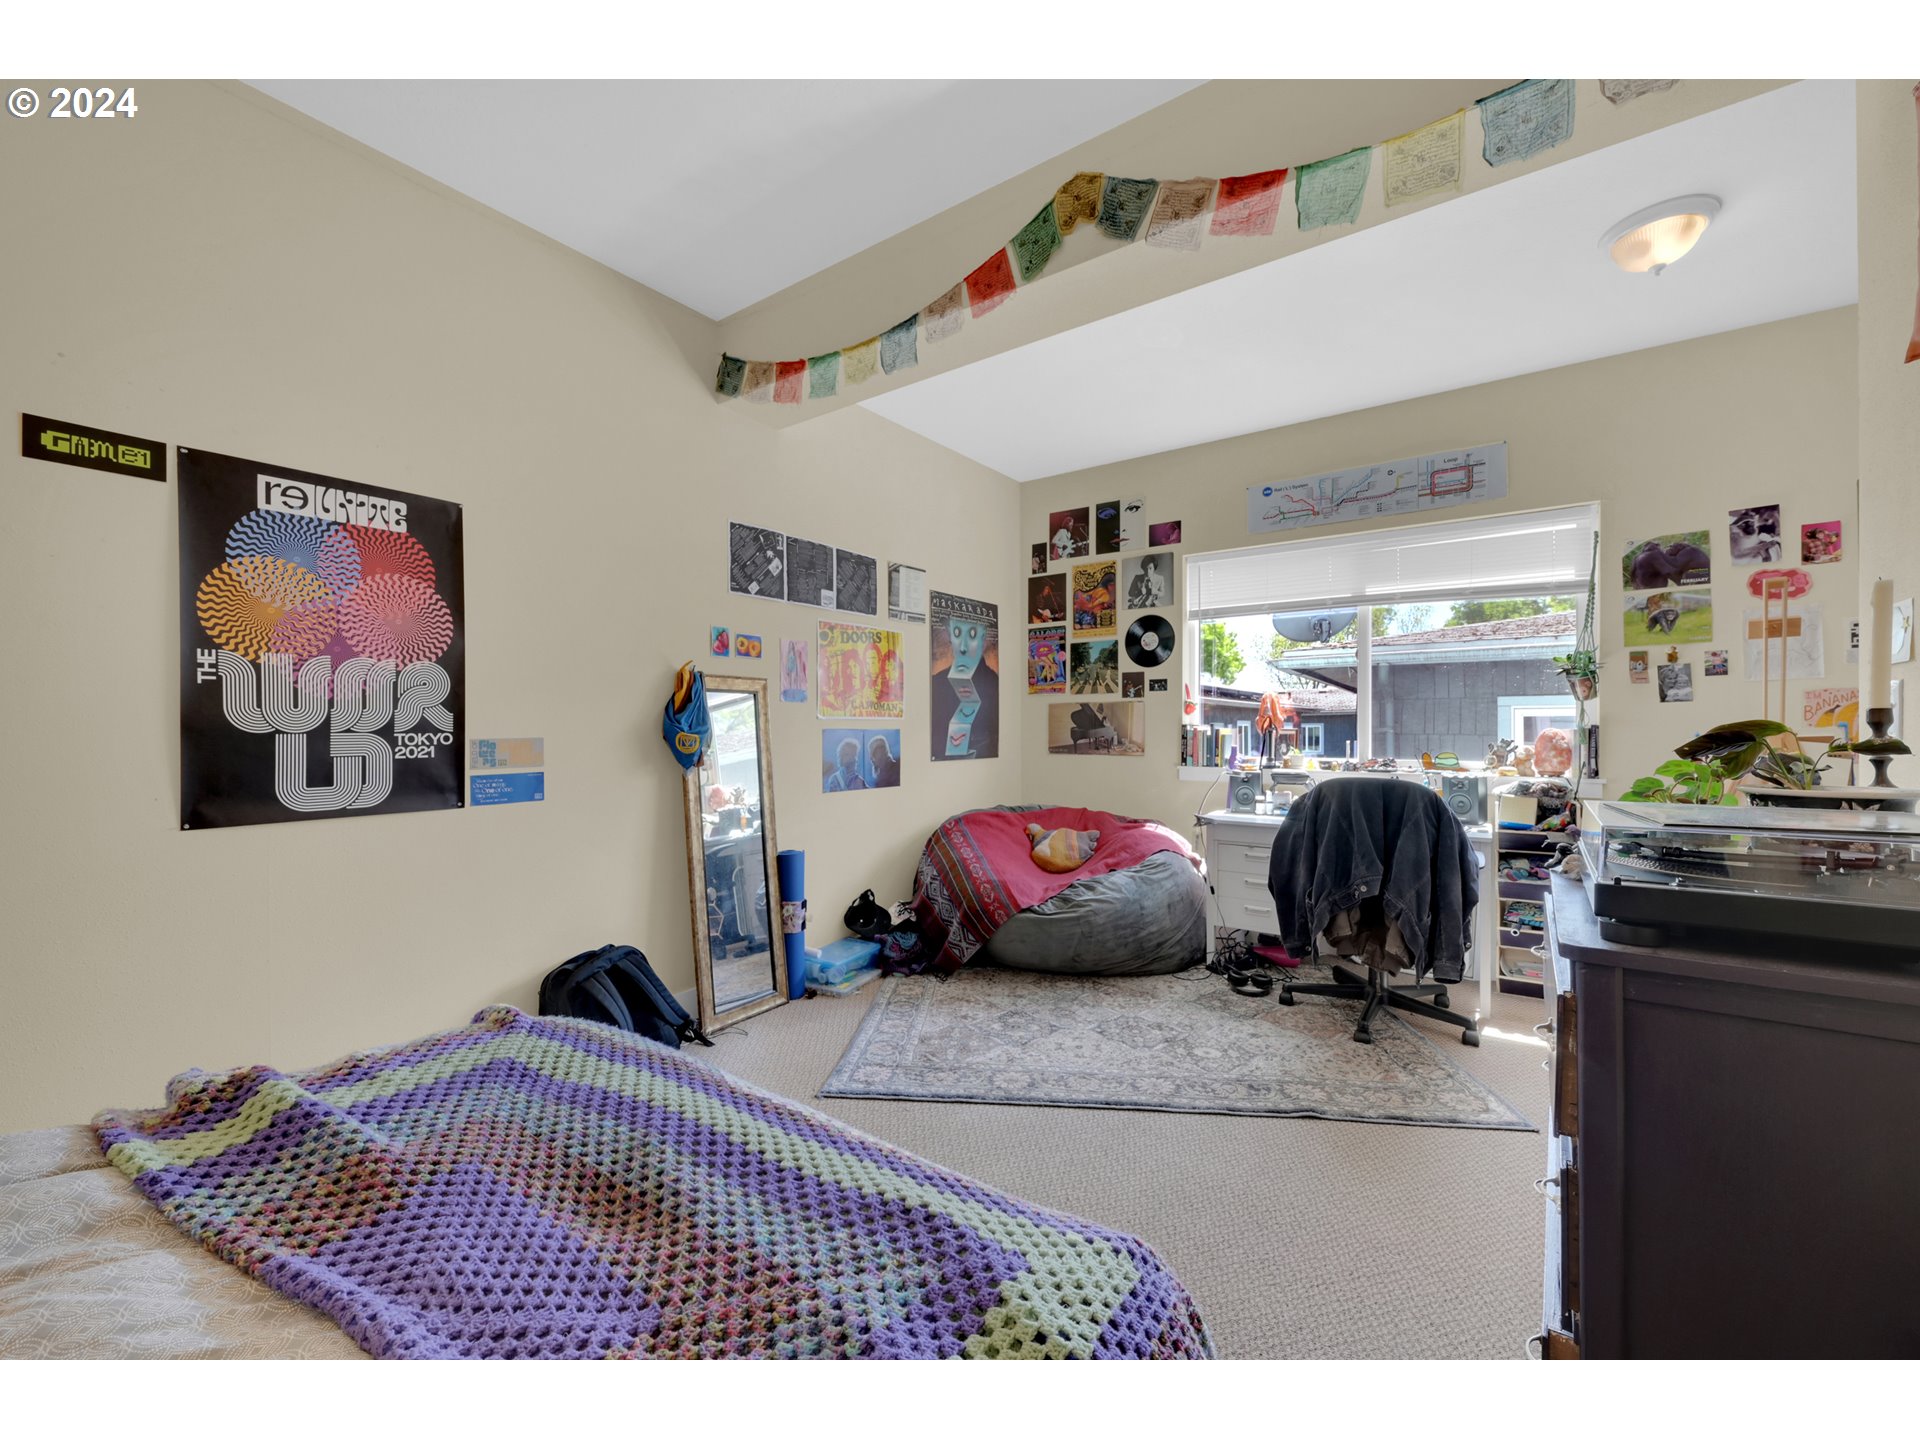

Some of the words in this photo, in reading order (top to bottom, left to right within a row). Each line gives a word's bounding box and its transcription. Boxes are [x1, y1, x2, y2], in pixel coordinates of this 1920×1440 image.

[840, 631, 882, 644] DOORS
[197, 648, 217, 684] THE
[394, 732, 454, 746] TOKYO
[394, 746, 436, 760] 2021
